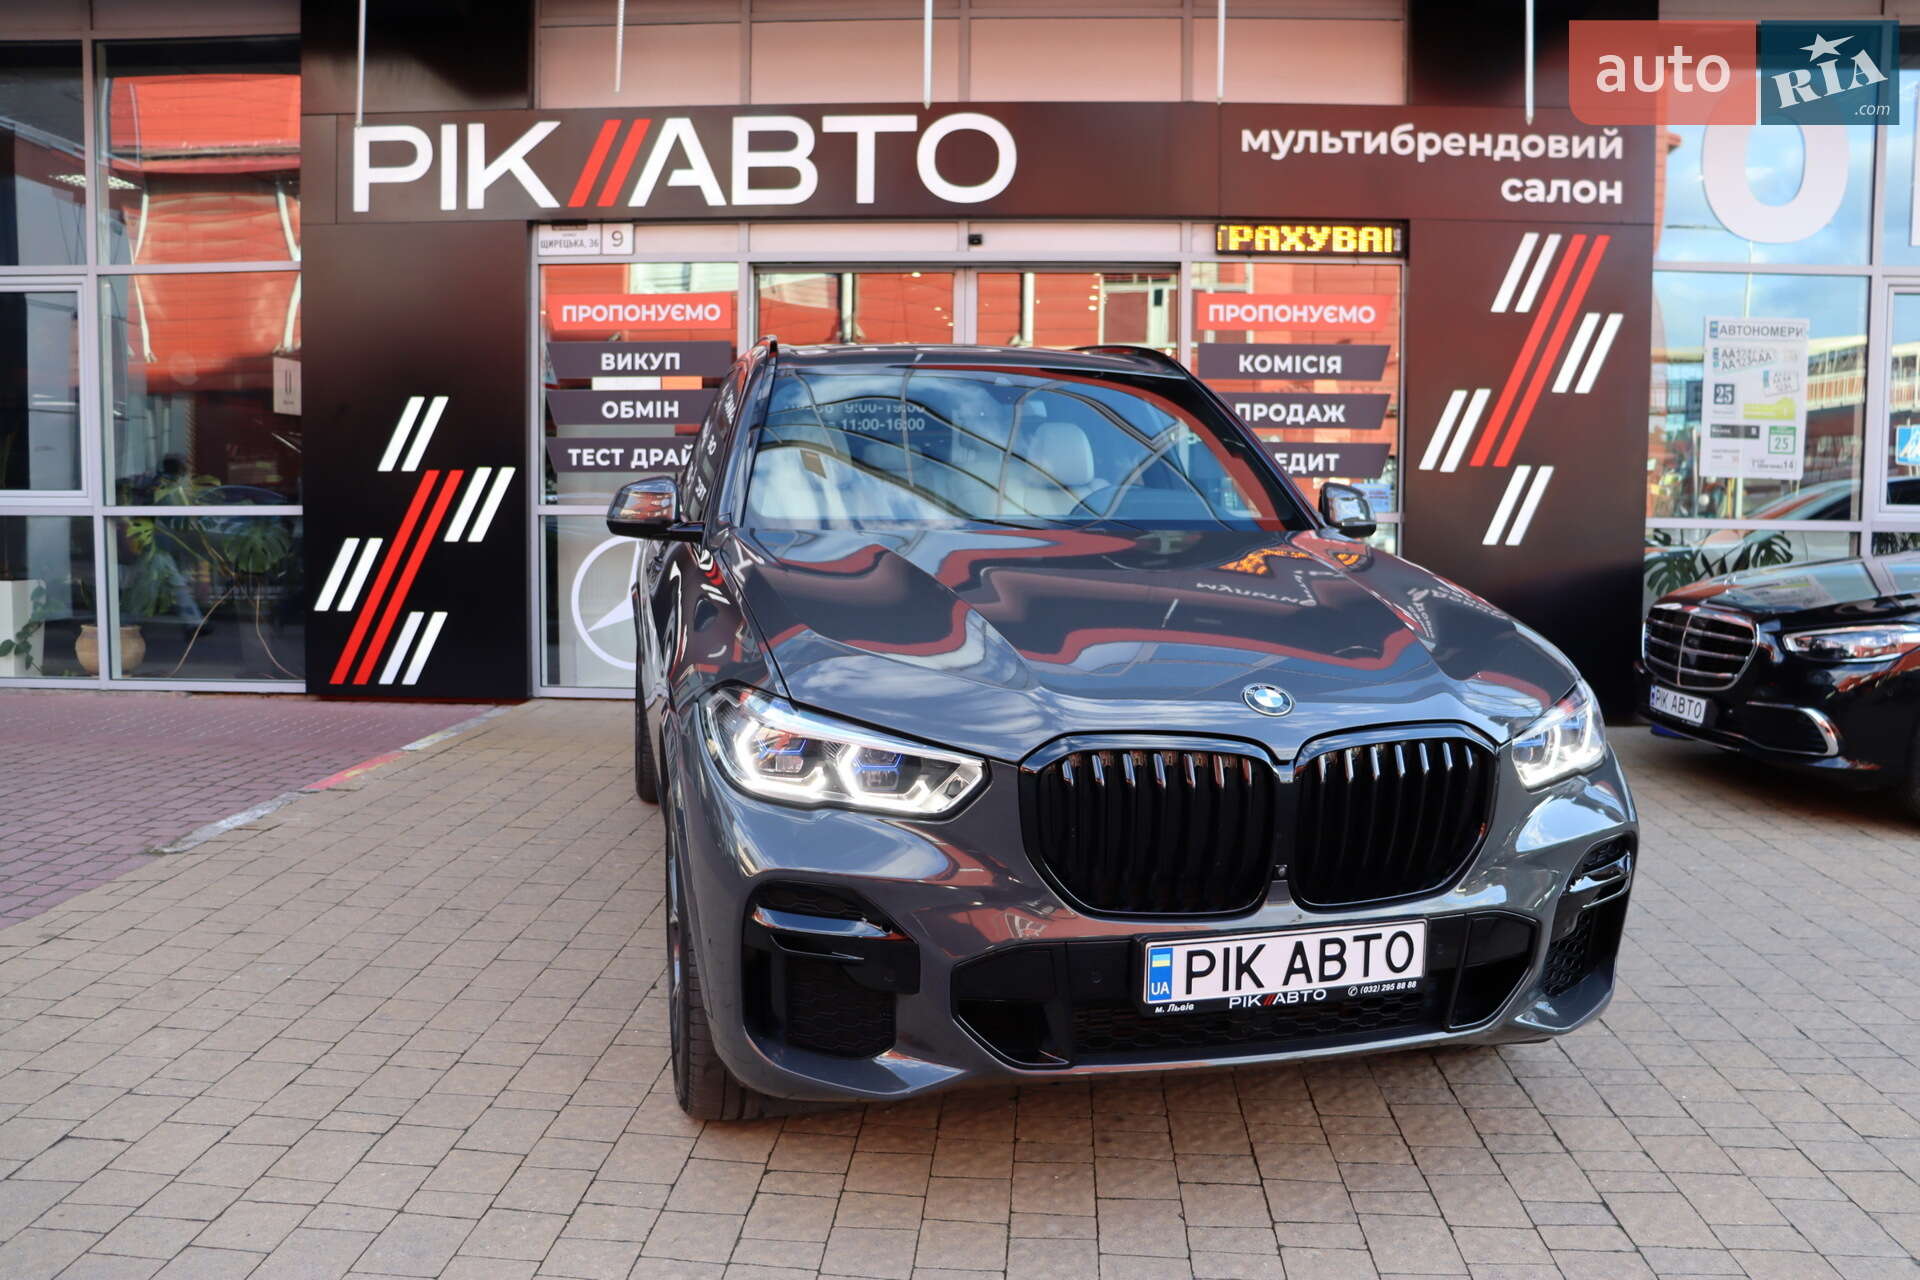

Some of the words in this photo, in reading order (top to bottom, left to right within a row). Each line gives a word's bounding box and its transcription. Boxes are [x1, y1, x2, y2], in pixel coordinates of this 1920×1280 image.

[1241, 123, 1623, 163] мультибрендовий
[1500, 178, 1623, 205] салон
[611, 230, 624, 247] 9
[562, 304, 721, 322] ПРОПОНУЄМО
[1208, 304, 1376, 324] ПРОПОНУЄМО
[1719, 325, 1803, 337] АВТОНОМЕРИ
[601, 353, 680, 371] ВИКУП
[1239, 354, 1342, 374] КОМІСІЯ
[1716, 386, 1733, 404] 25
[602, 401, 679, 419] ОБМІН
[1235, 404, 1346, 425] ПРОДАЖ
[1774, 437, 1789, 450] 25
[568, 448, 624, 467] ТЕСТ
[1151, 982, 1170, 996] UA
[1360, 985, 1380, 994] (032)
